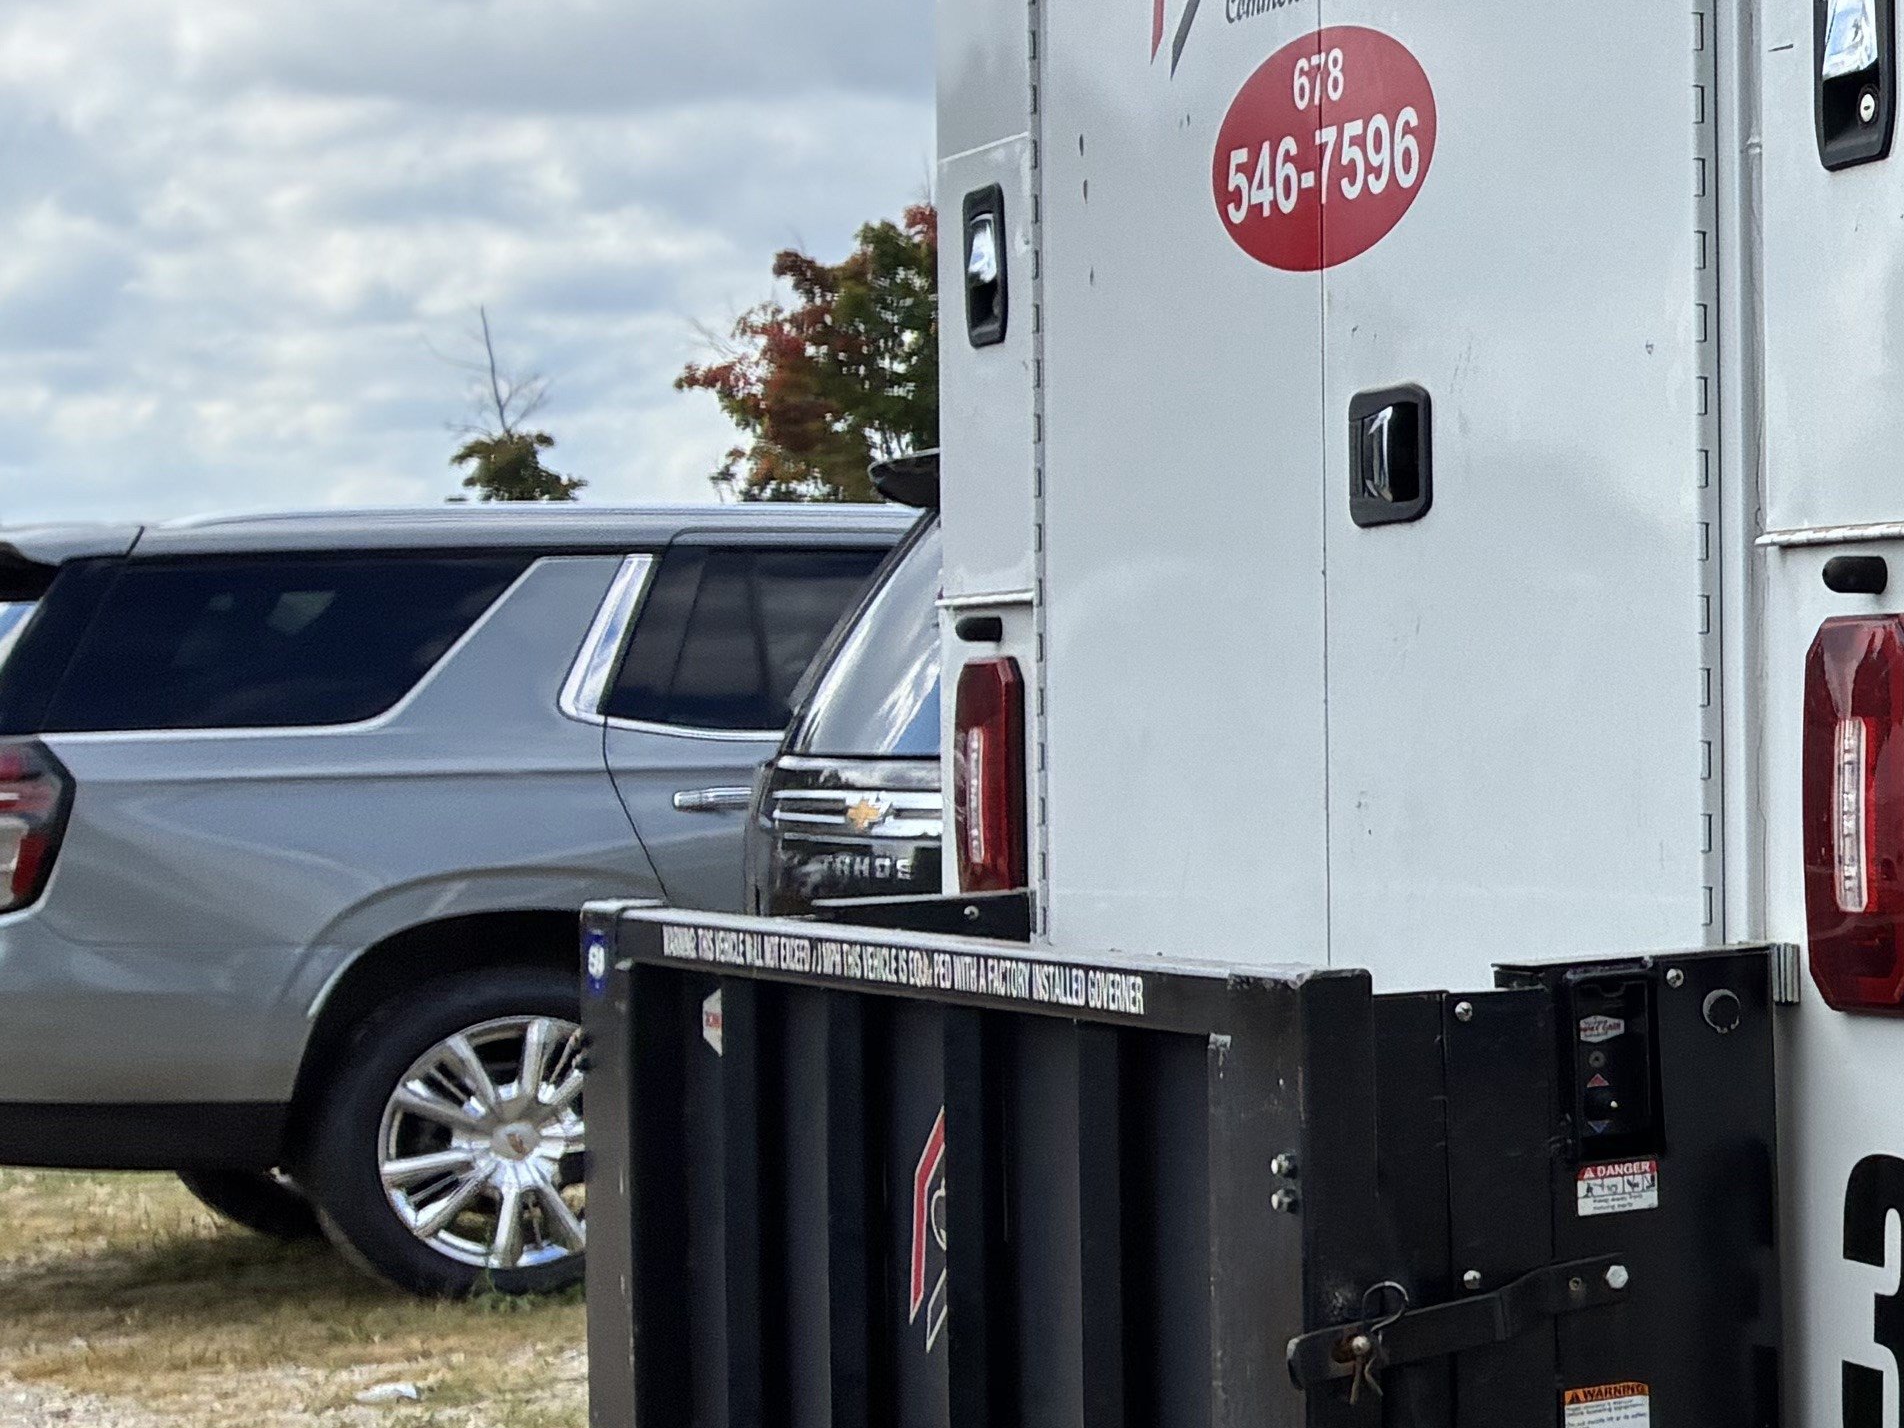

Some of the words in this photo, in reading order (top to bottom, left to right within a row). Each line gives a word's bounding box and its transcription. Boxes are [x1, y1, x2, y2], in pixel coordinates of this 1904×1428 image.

[1292, 47, 1345, 111] 678
[1226, 106, 1420, 226] 546-7596
[952, 954, 978, 992] WITH
[978, 957, 987, 994] A
[987, 958, 1031, 1000] FACTORY
[1031, 962, 1086, 1006] INSTALLED
[1087, 969, 1145, 1015] GOVERNER
[1596, 1161, 1650, 1177] DANGER
[1584, 1383, 1645, 1403] WARNING
